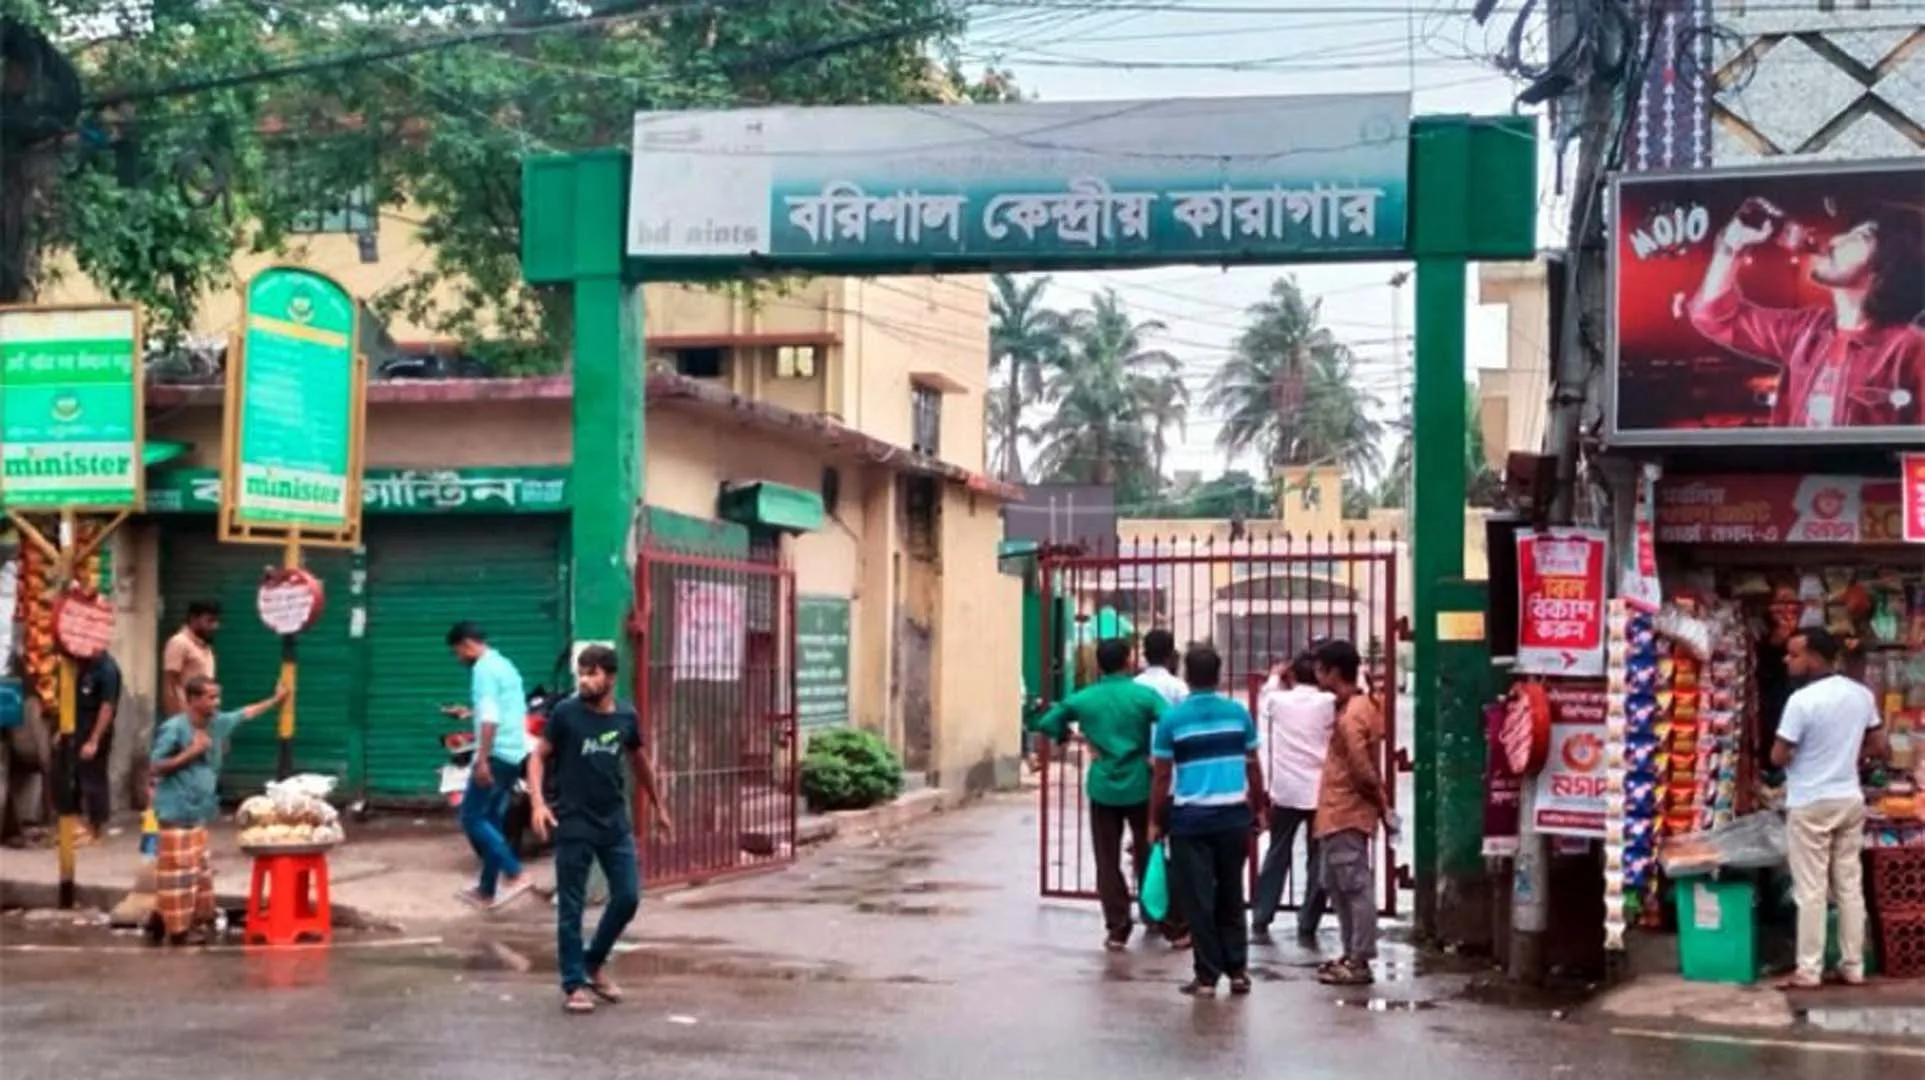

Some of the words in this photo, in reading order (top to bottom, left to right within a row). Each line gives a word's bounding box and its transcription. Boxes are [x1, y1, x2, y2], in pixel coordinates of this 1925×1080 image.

[784, 180, 967, 244] বরিশাল
[983, 177, 1158, 248] কেন্দ্রীয়
[1167, 184, 1384, 241] কারাগার
[1630, 206, 1710, 260] MOJO
[4, 451, 131, 477] minister
[246, 470, 341, 505] minister
[1527, 592, 1597, 621] বিকাশ
